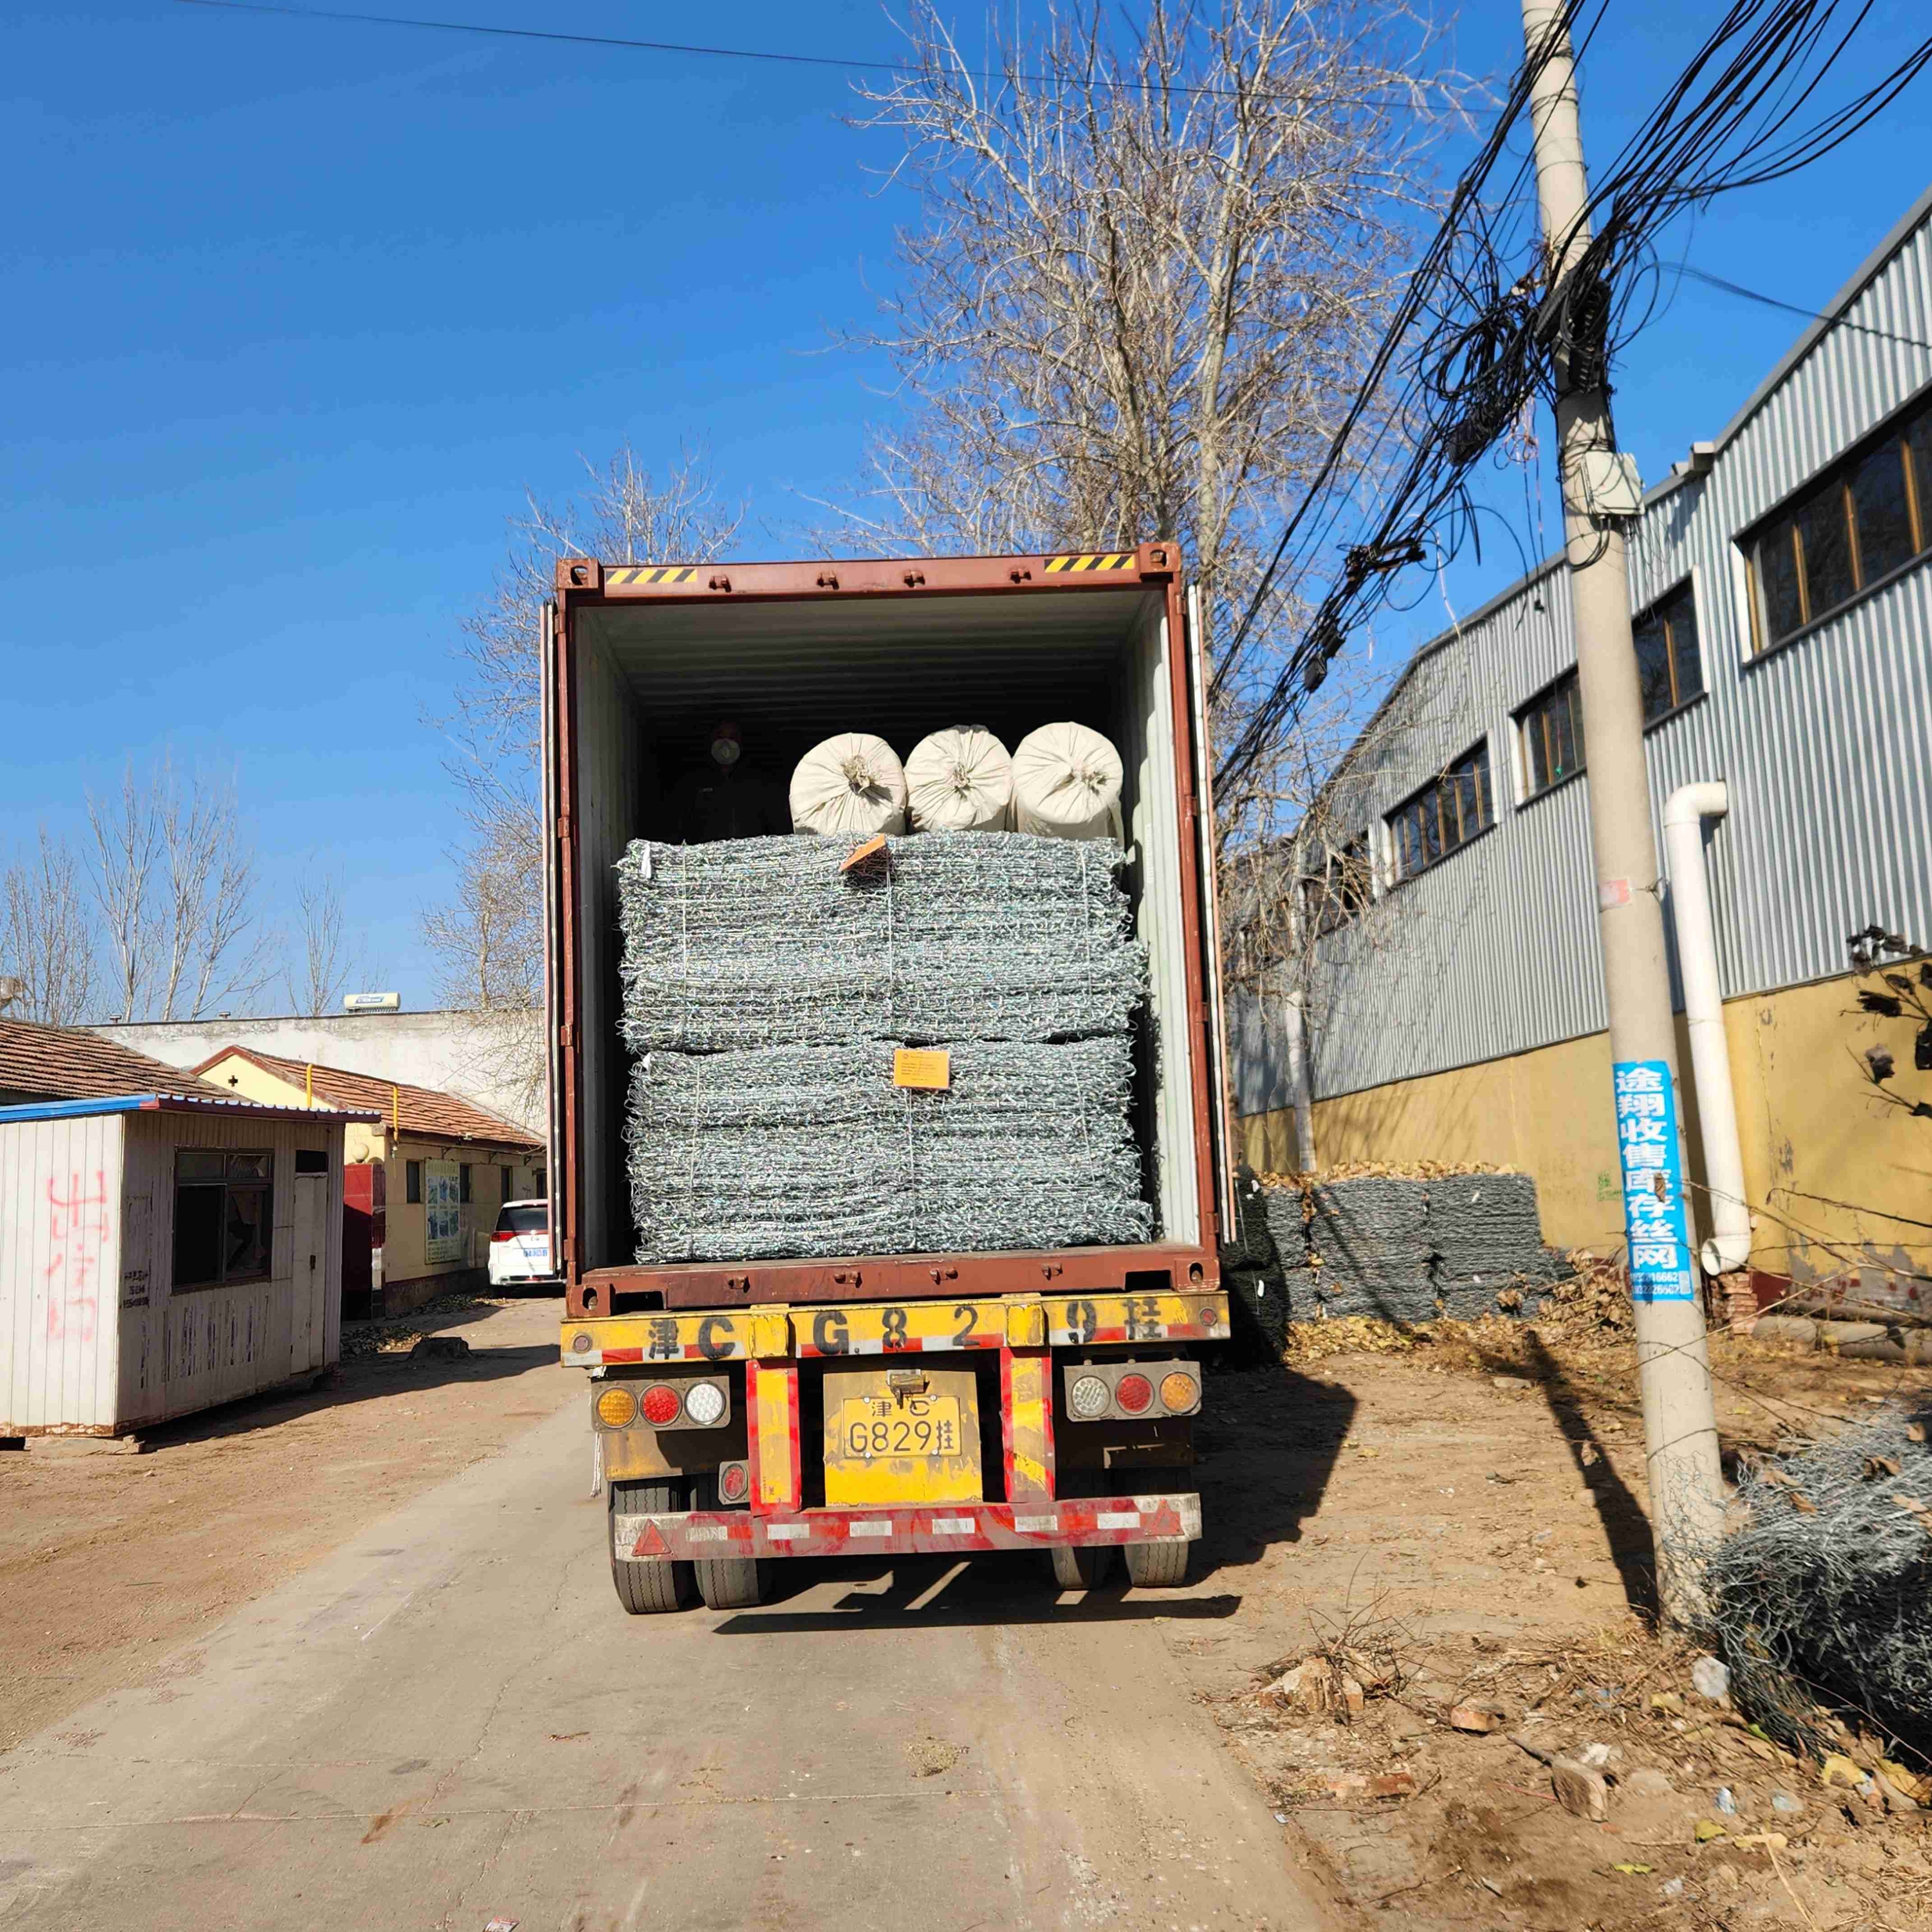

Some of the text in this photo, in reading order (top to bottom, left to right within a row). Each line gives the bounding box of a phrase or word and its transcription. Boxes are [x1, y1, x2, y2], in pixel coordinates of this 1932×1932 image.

[1616, 1067, 1678, 1270] 途翔收售库存丝网
[850, 1419, 954, 1453] G829挂
